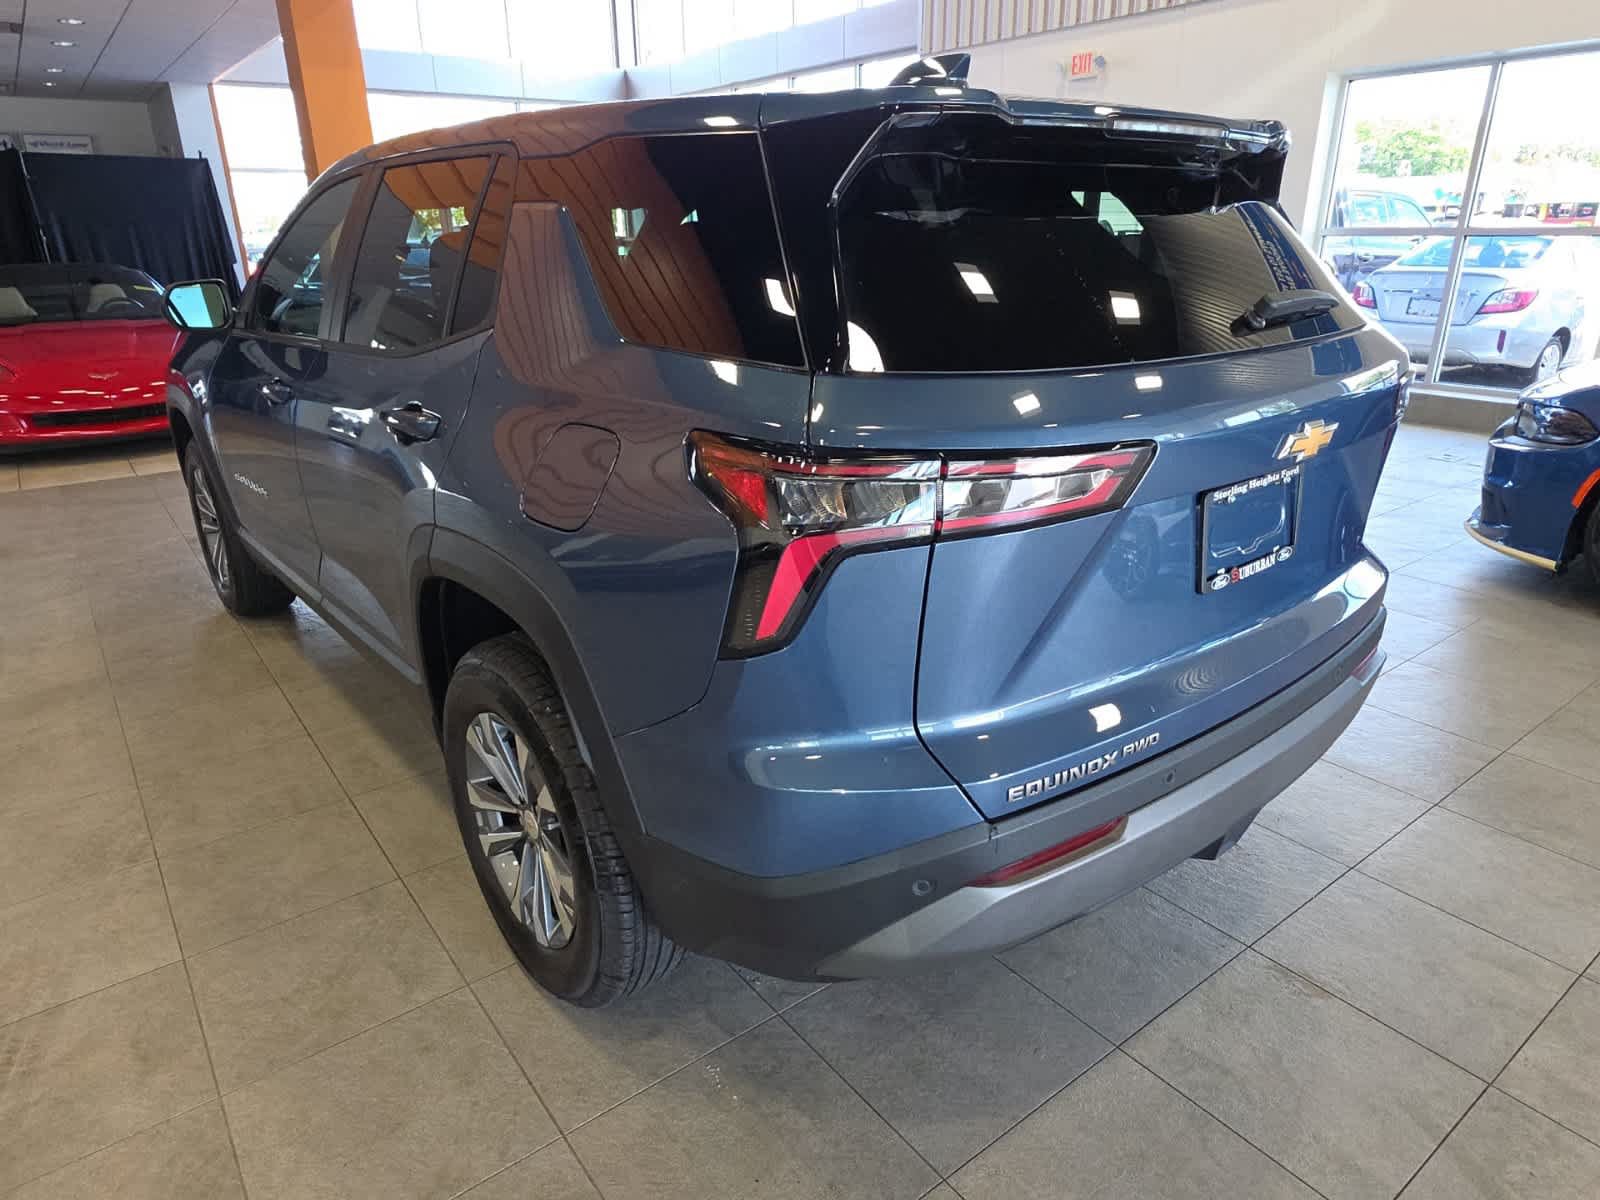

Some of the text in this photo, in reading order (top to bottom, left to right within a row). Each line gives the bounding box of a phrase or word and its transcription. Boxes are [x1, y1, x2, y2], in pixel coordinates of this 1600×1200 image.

[1071, 52, 1092, 74] EXIT
[1213, 464, 1299, 501] Sterling Heights Ford
[1231, 554, 1276, 583] SUBURBAN
[1008, 732, 1160, 802] EQUINOX AWD
